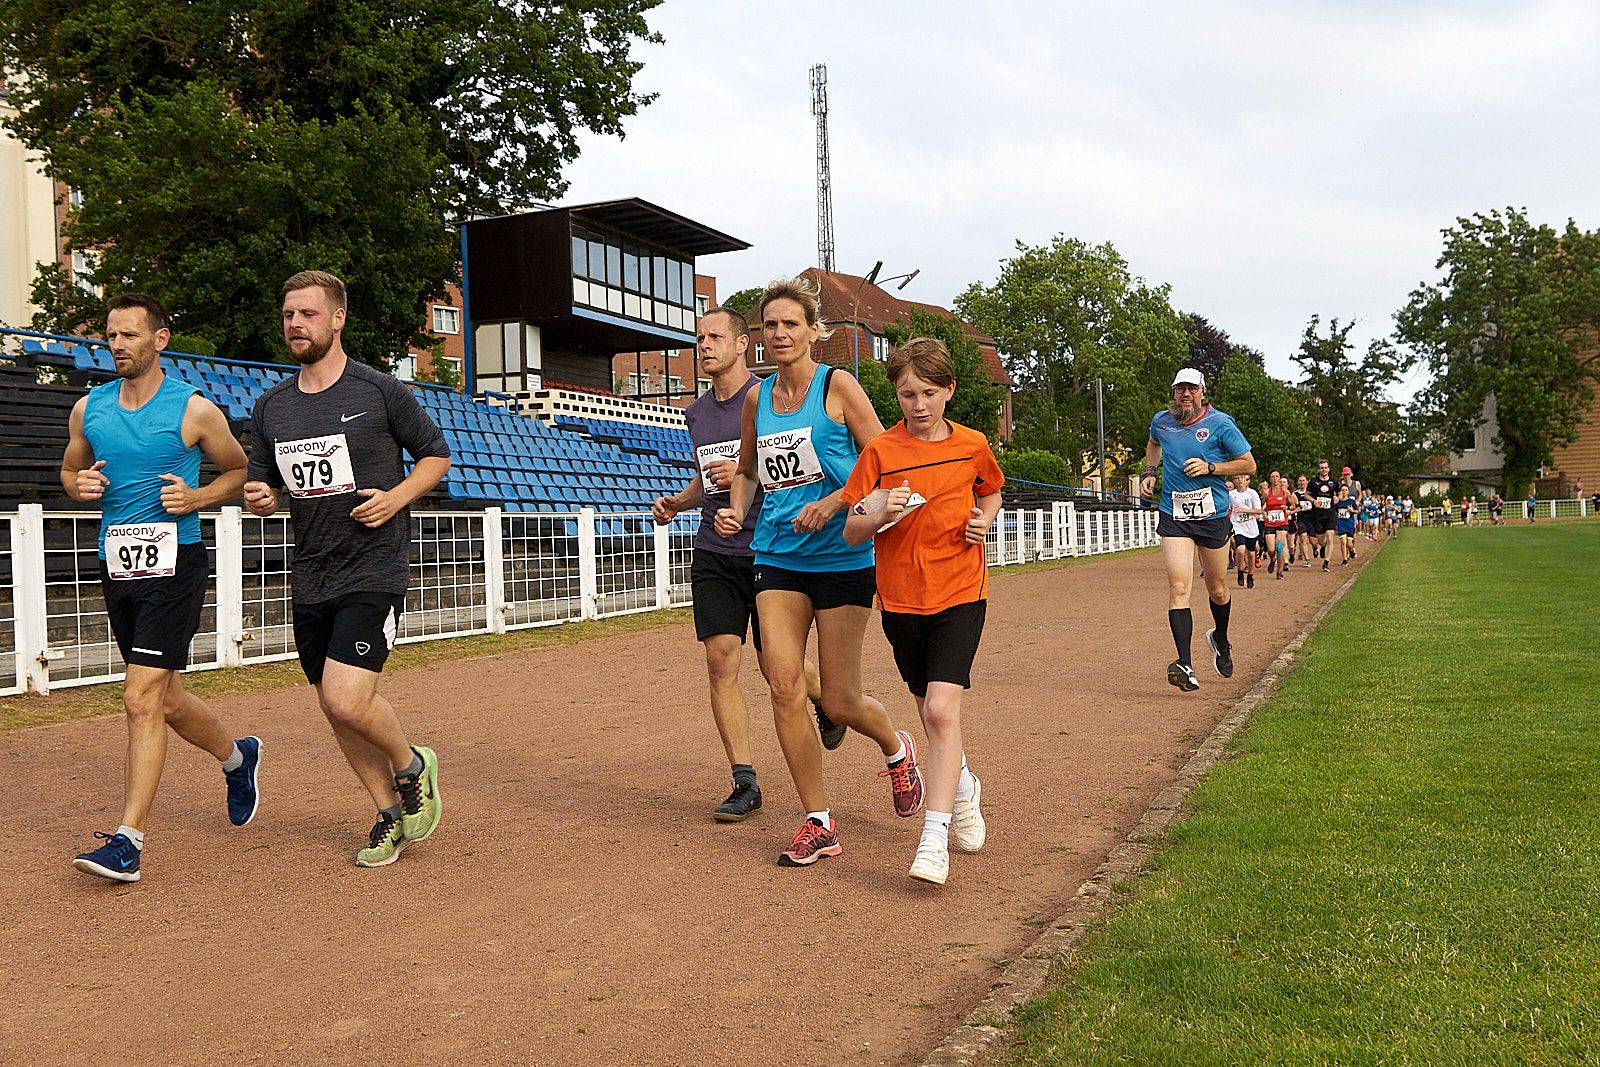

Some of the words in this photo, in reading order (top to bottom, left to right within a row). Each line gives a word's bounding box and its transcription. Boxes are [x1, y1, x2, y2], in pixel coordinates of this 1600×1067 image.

[278, 440, 327, 455] saucony
[758, 434, 794, 448] ucony
[700, 444, 735, 457] saucony
[291, 459, 333, 488] 979
[765, 451, 805, 481] 602
[1174, 491, 1202, 499] saucony
[1182, 501, 1204, 516] 671
[106, 526, 156, 537] saucony
[118, 544, 159, 570] 978
